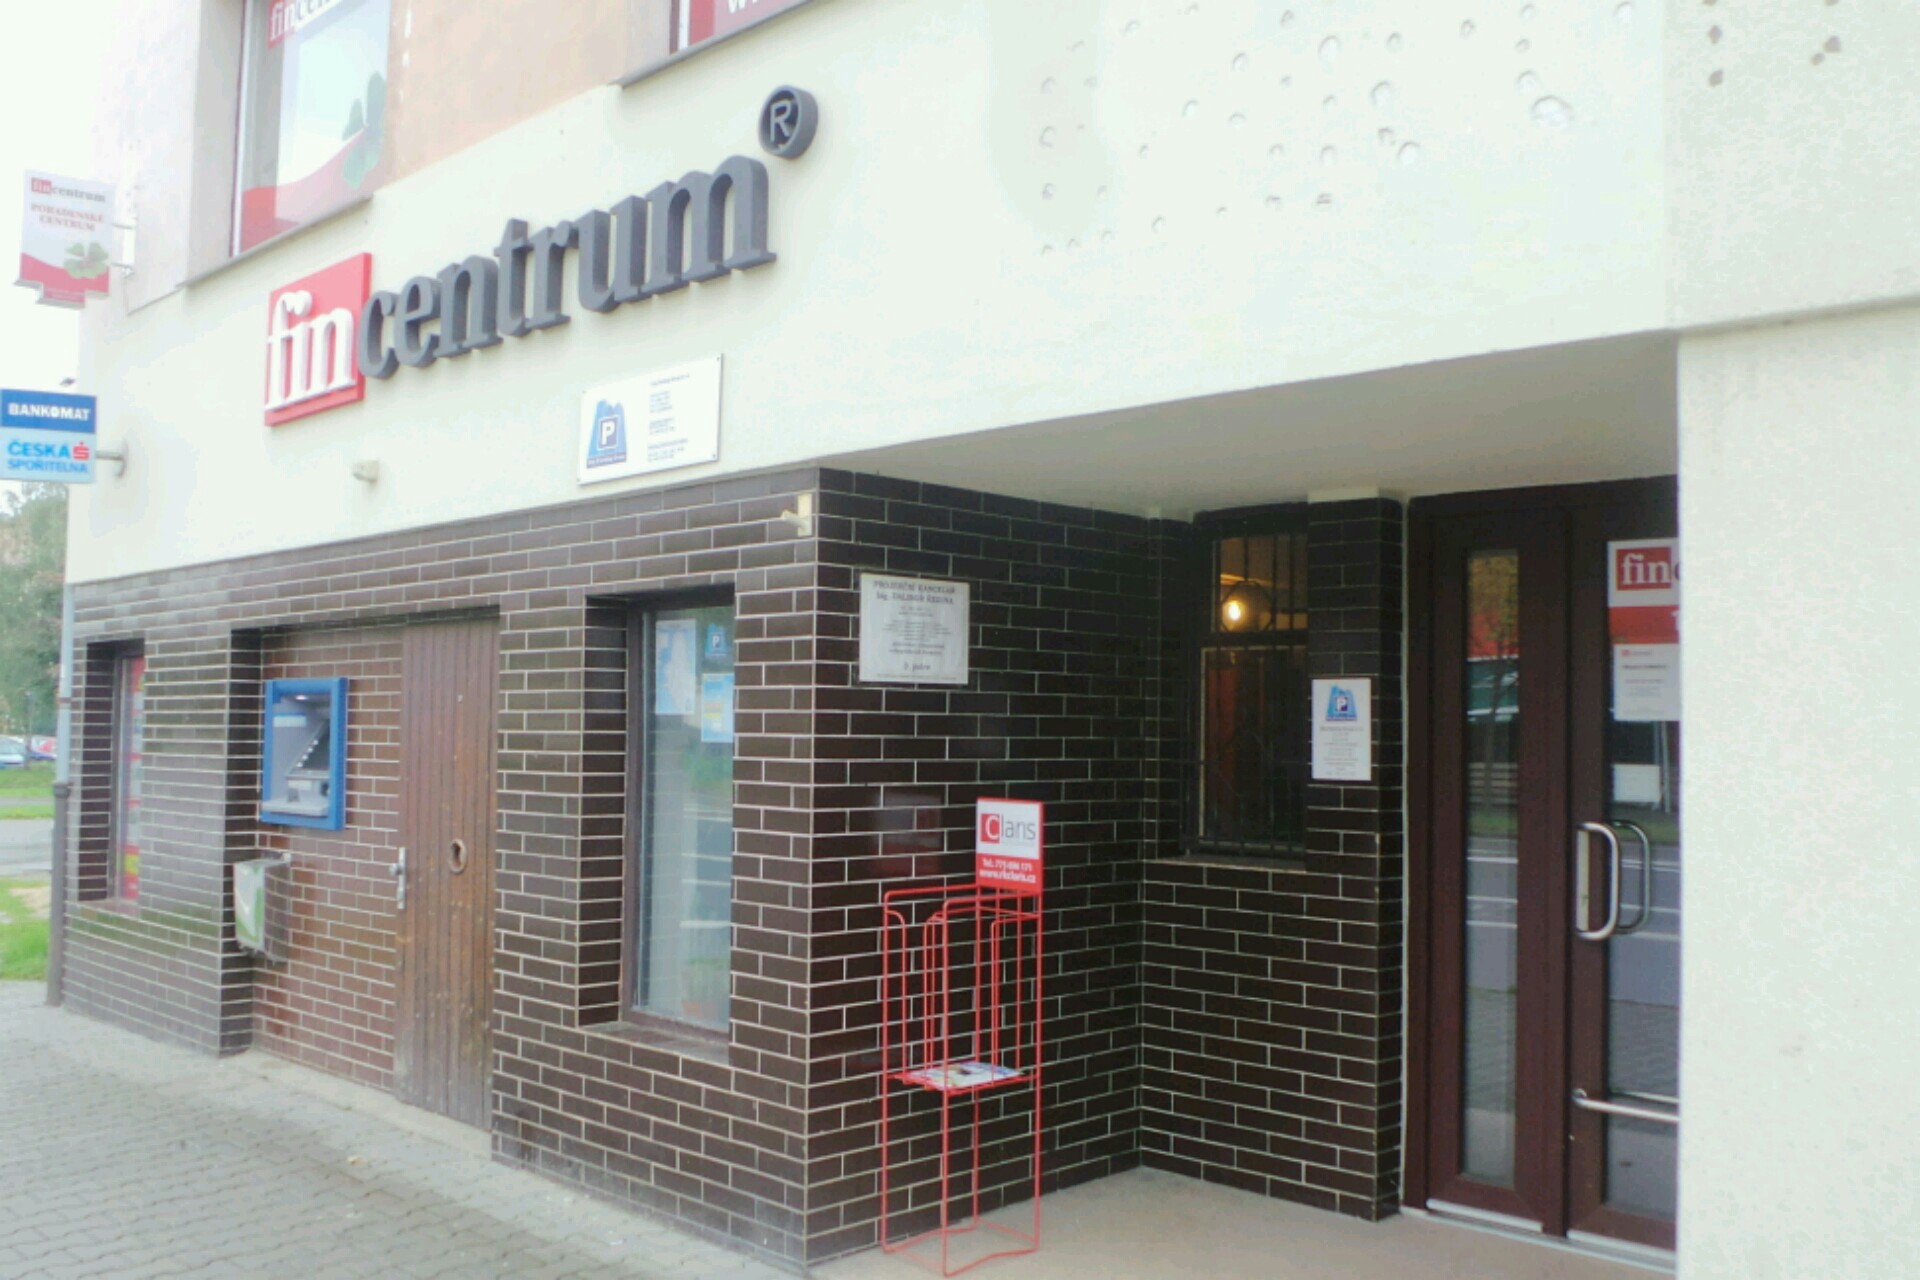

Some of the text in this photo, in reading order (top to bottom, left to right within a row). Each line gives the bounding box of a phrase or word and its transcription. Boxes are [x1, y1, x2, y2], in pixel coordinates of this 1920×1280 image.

[264, 155, 776, 412] fincentrum
[8, 403, 90, 420] BANKOMAT
[1622, 552, 1679, 585] fin
